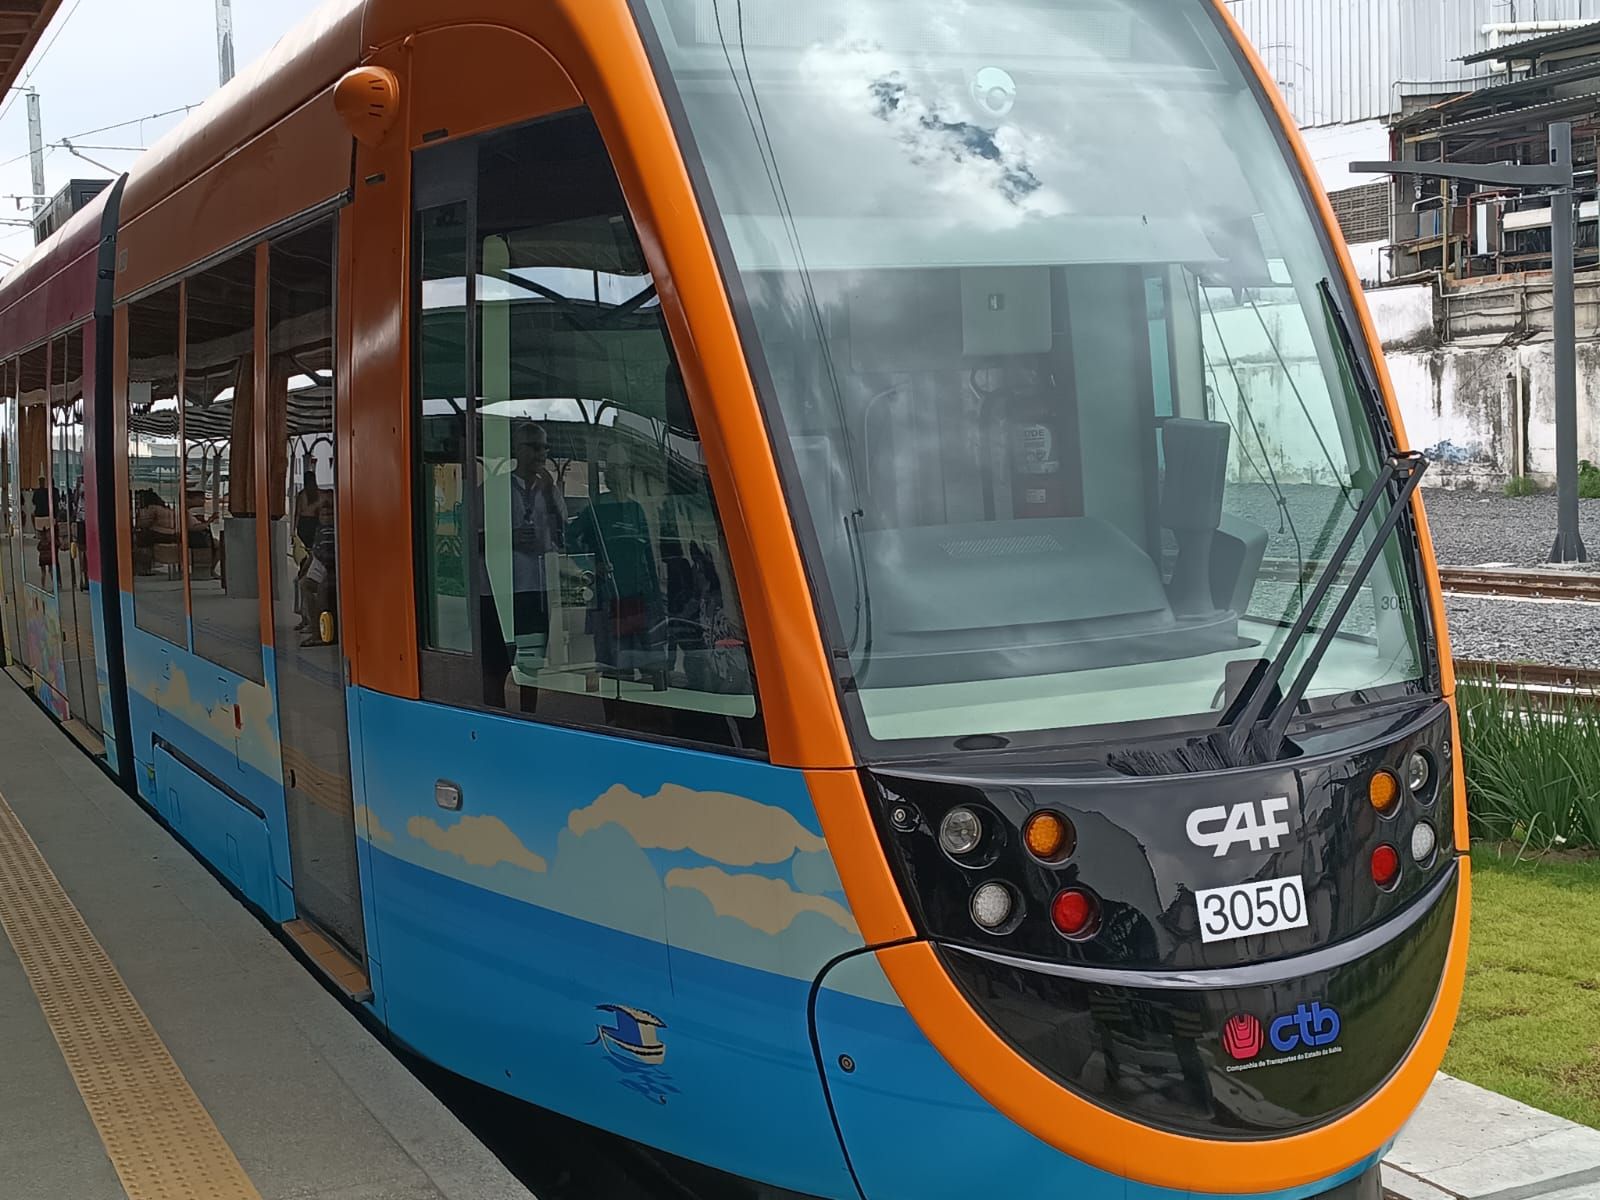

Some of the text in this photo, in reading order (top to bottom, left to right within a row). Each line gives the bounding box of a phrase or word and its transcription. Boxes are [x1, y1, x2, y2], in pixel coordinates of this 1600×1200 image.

[1186, 797, 1290, 857] CAF
[1204, 882, 1301, 935] 3050
[1269, 1001, 1340, 1052] ctb
[1226, 1061, 1258, 1072] Companhia
[1266, 1056, 1297, 1066] Transportes
[1304, 1050, 1321, 1059] Estado
